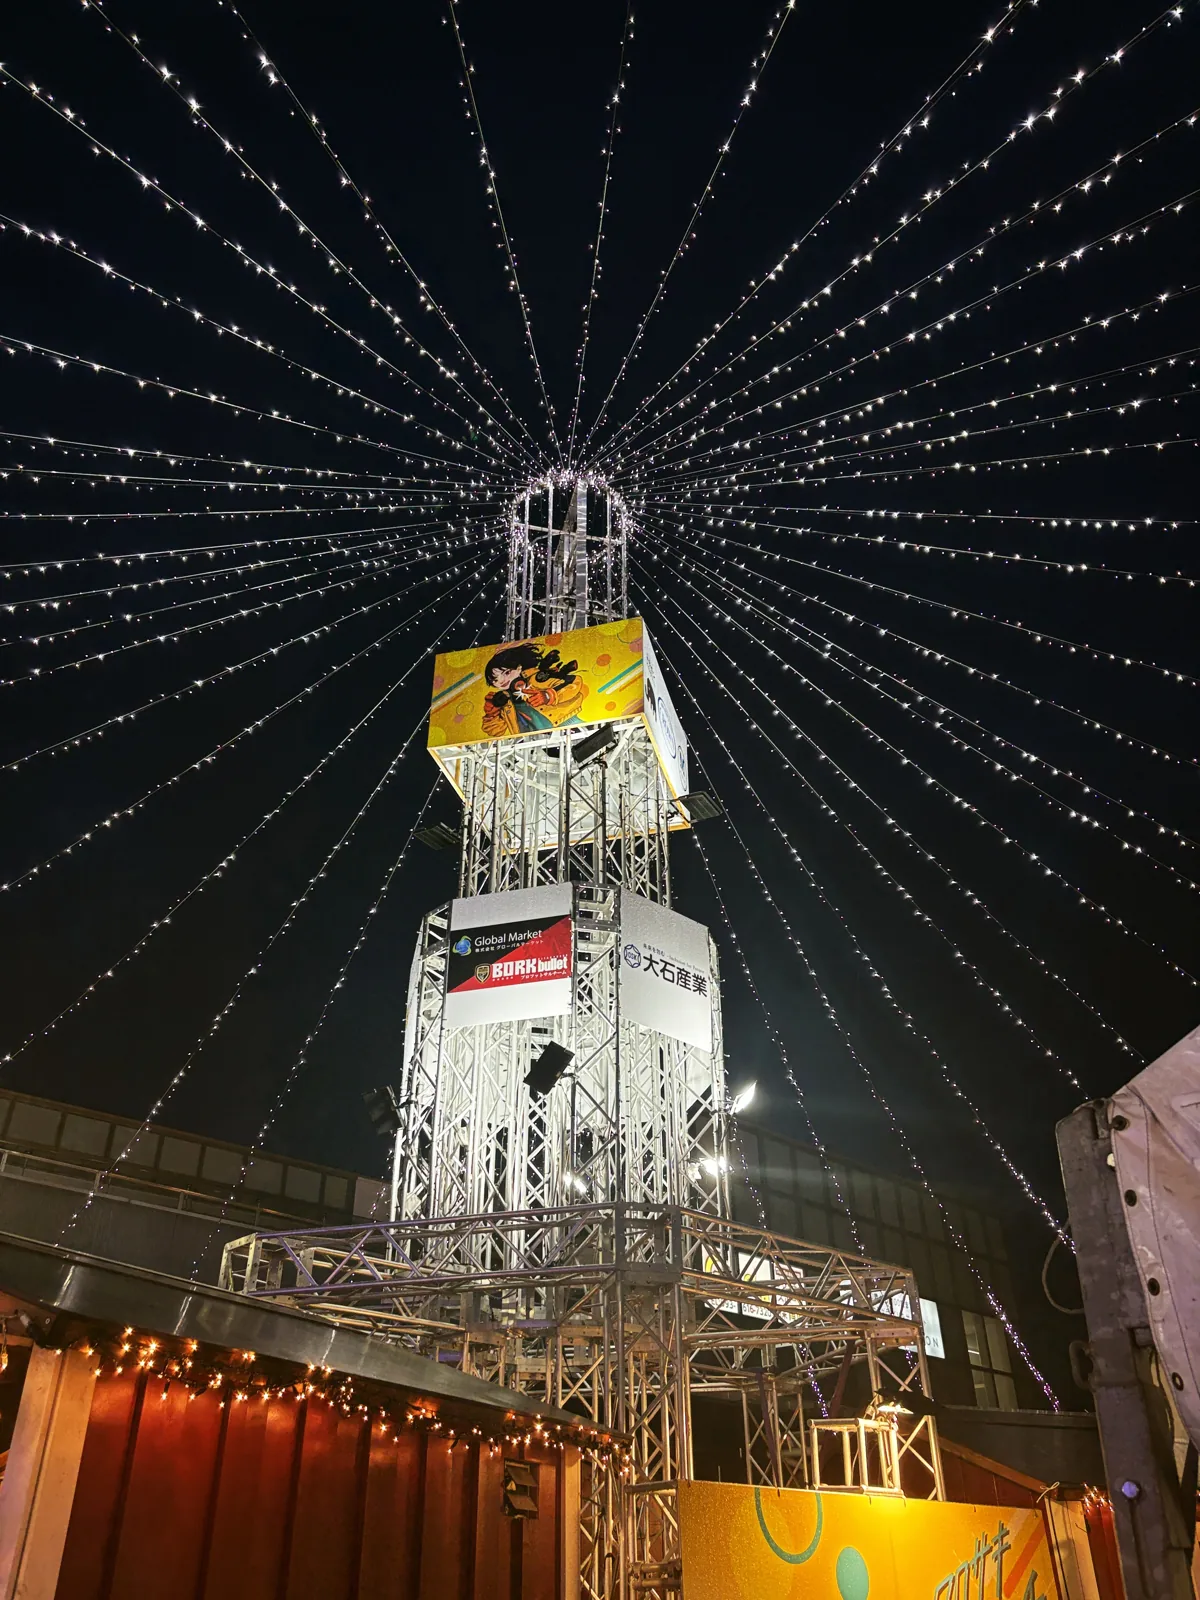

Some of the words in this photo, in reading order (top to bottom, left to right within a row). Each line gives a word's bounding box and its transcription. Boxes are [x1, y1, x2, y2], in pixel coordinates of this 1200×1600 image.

[474, 933, 506, 947] Global
[508, 930, 542, 942] Market
[537, 956, 568, 973] bullet
[643, 953, 707, 998] 大石産業
